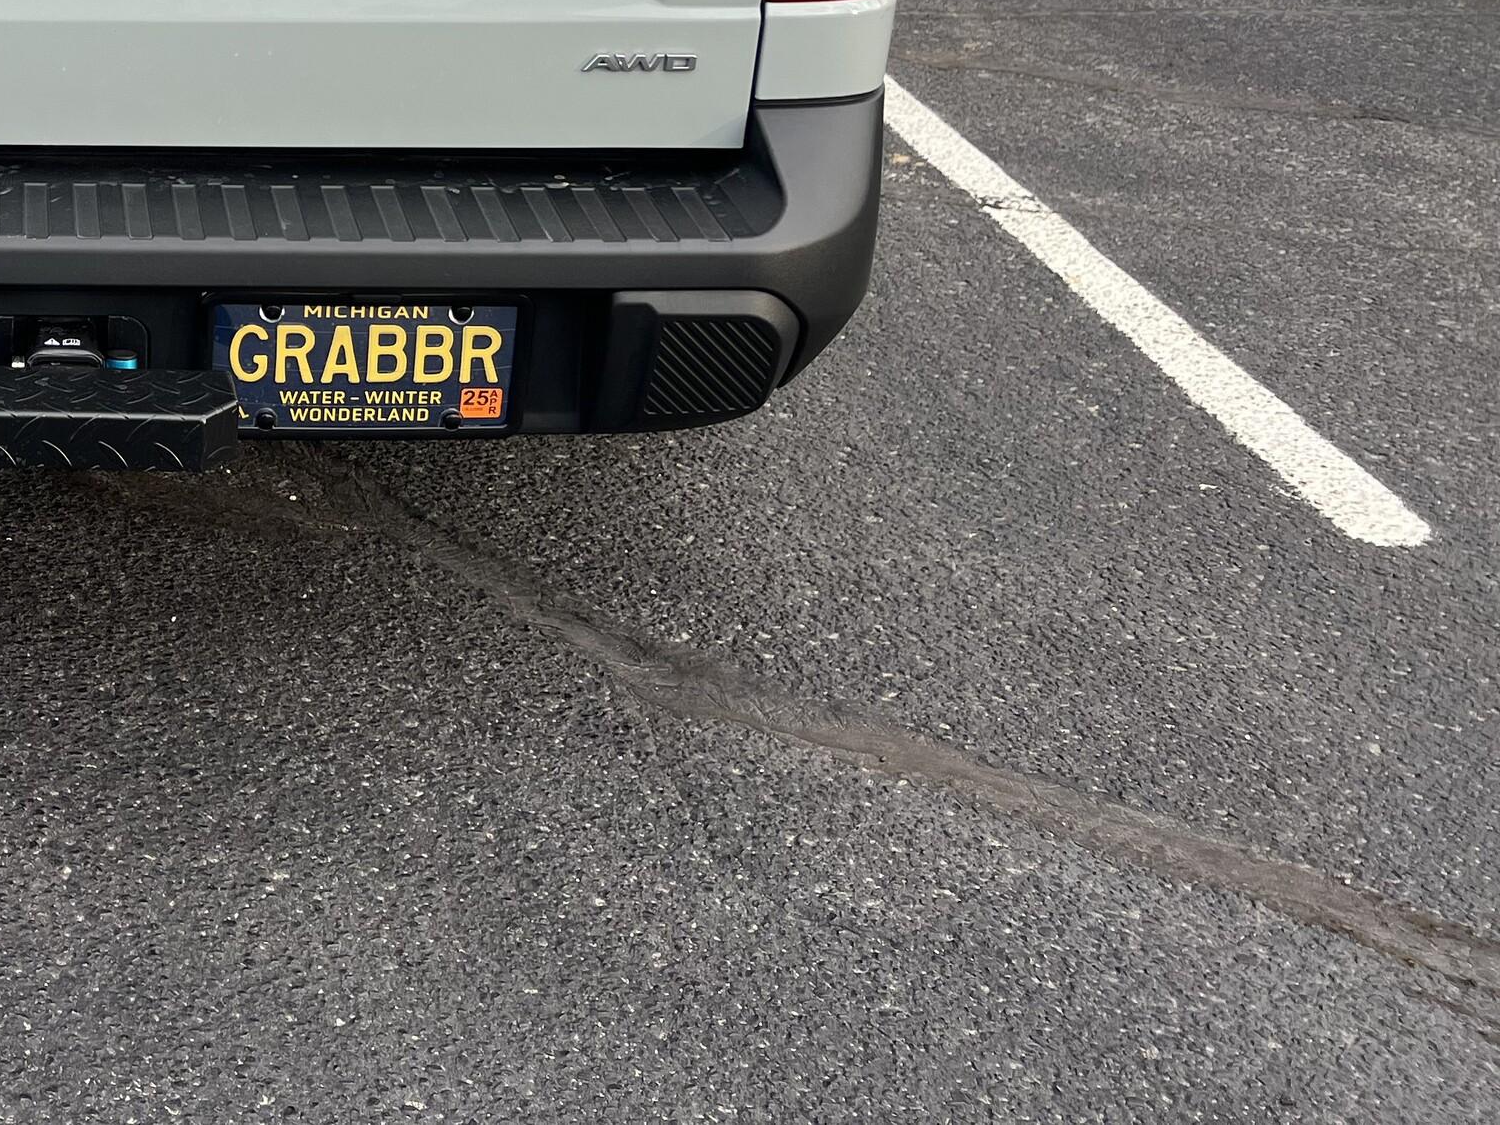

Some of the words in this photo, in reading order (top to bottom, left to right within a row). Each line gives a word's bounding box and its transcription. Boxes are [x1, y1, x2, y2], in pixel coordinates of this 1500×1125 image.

[580, 54, 698, 72] AWD
[303, 305, 429, 319] MICHIGAN
[229, 324, 502, 384] GRABBR
[279, 390, 345, 404] WATER
[365, 390, 442, 405] WINTER
[463, 390, 489, 406] 25
[289, 407, 429, 422] WONDERLAND
